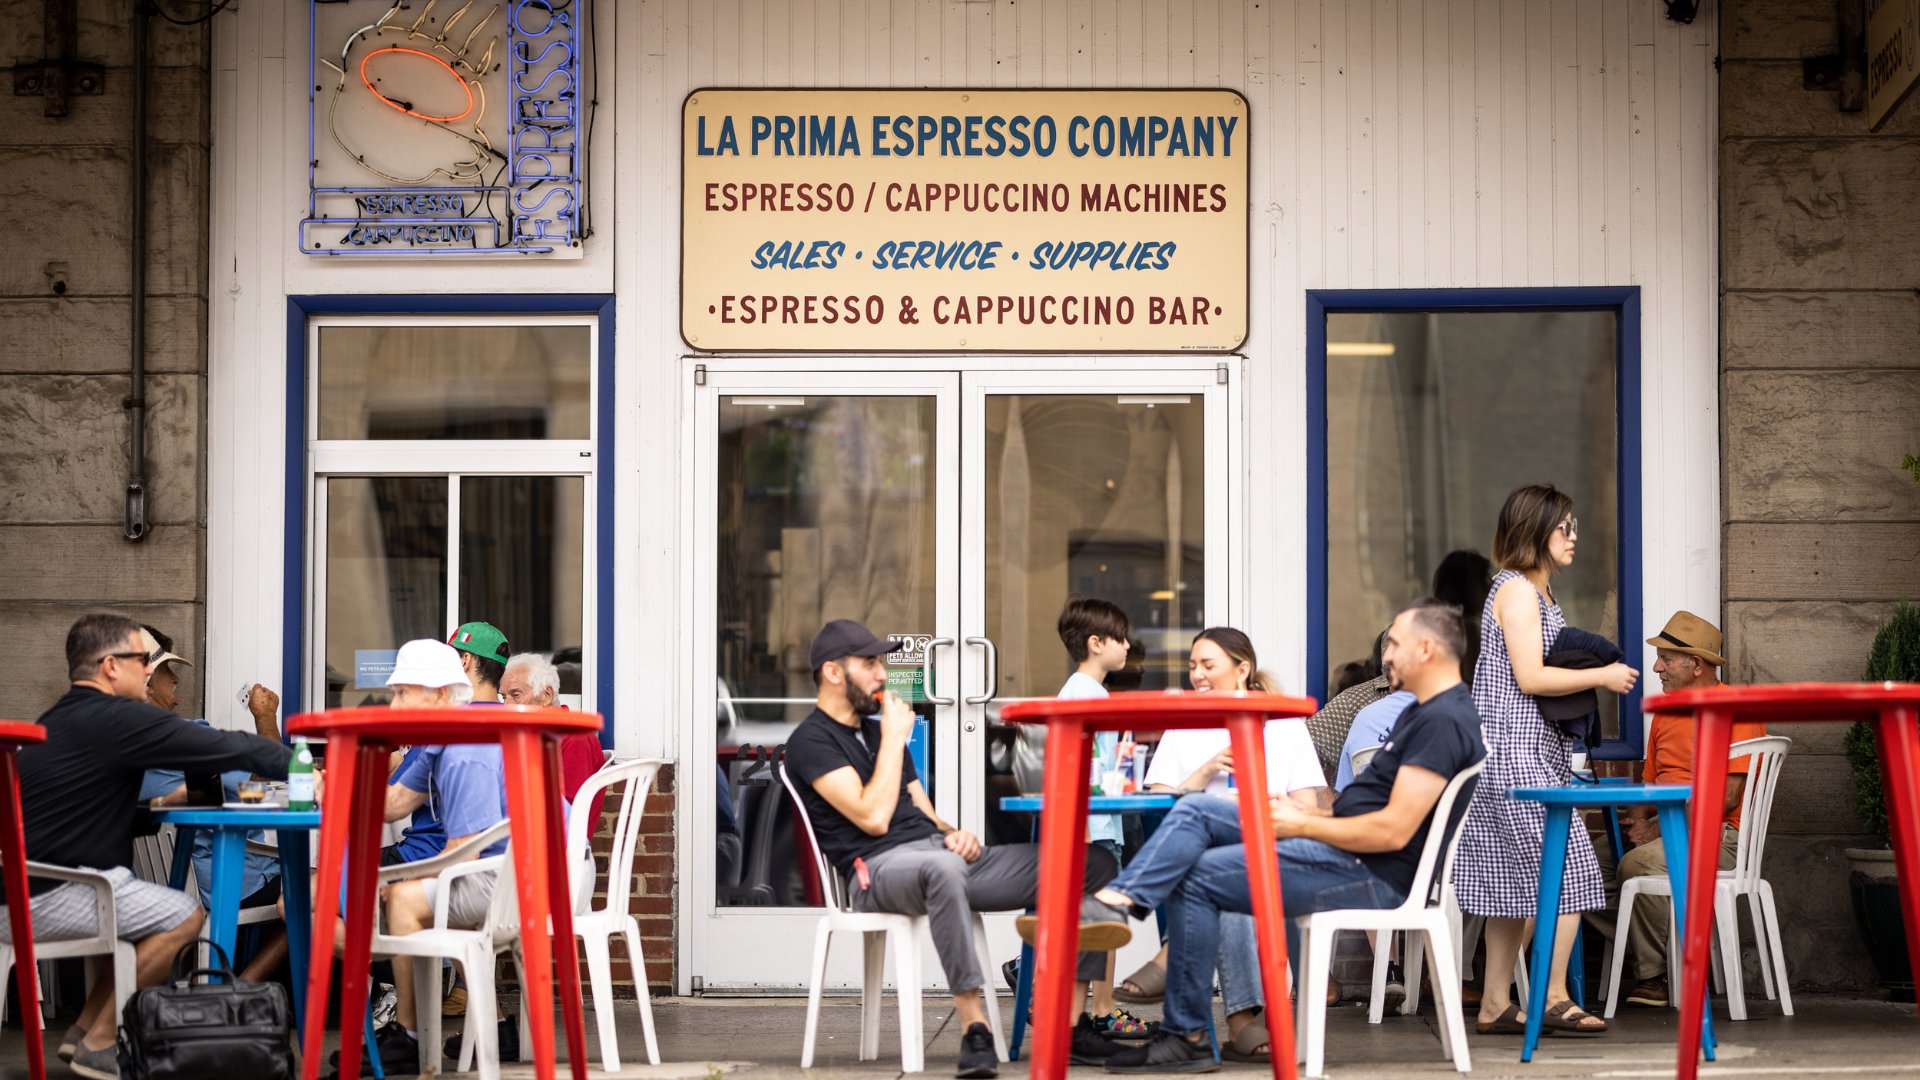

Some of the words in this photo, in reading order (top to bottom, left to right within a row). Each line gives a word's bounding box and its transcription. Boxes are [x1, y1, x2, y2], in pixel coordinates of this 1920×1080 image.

[513, 0, 574, 246] ESPRESSO
[697, 115, 740, 157] LA
[750, 115, 861, 157] PRIMA
[871, 115, 1057, 157] ESPRESSO
[1067, 115, 1239, 157] COMPANY
[366, 195, 463, 215] ESPRESSO
[705, 183, 855, 212] ESPRESSO
[885, 183, 1070, 213] CAPPUCCINO
[1080, 183, 1227, 213] MACHINES
[348, 225, 474, 244] CAPPUCCINO
[750, 240, 846, 271] SALES
[872, 240, 1003, 271] SERVICE
[1029, 240, 1177, 272] SUPPLIES
[898, 295, 920, 325] &
[933, 295, 1135, 326] CAPPUCCINO
